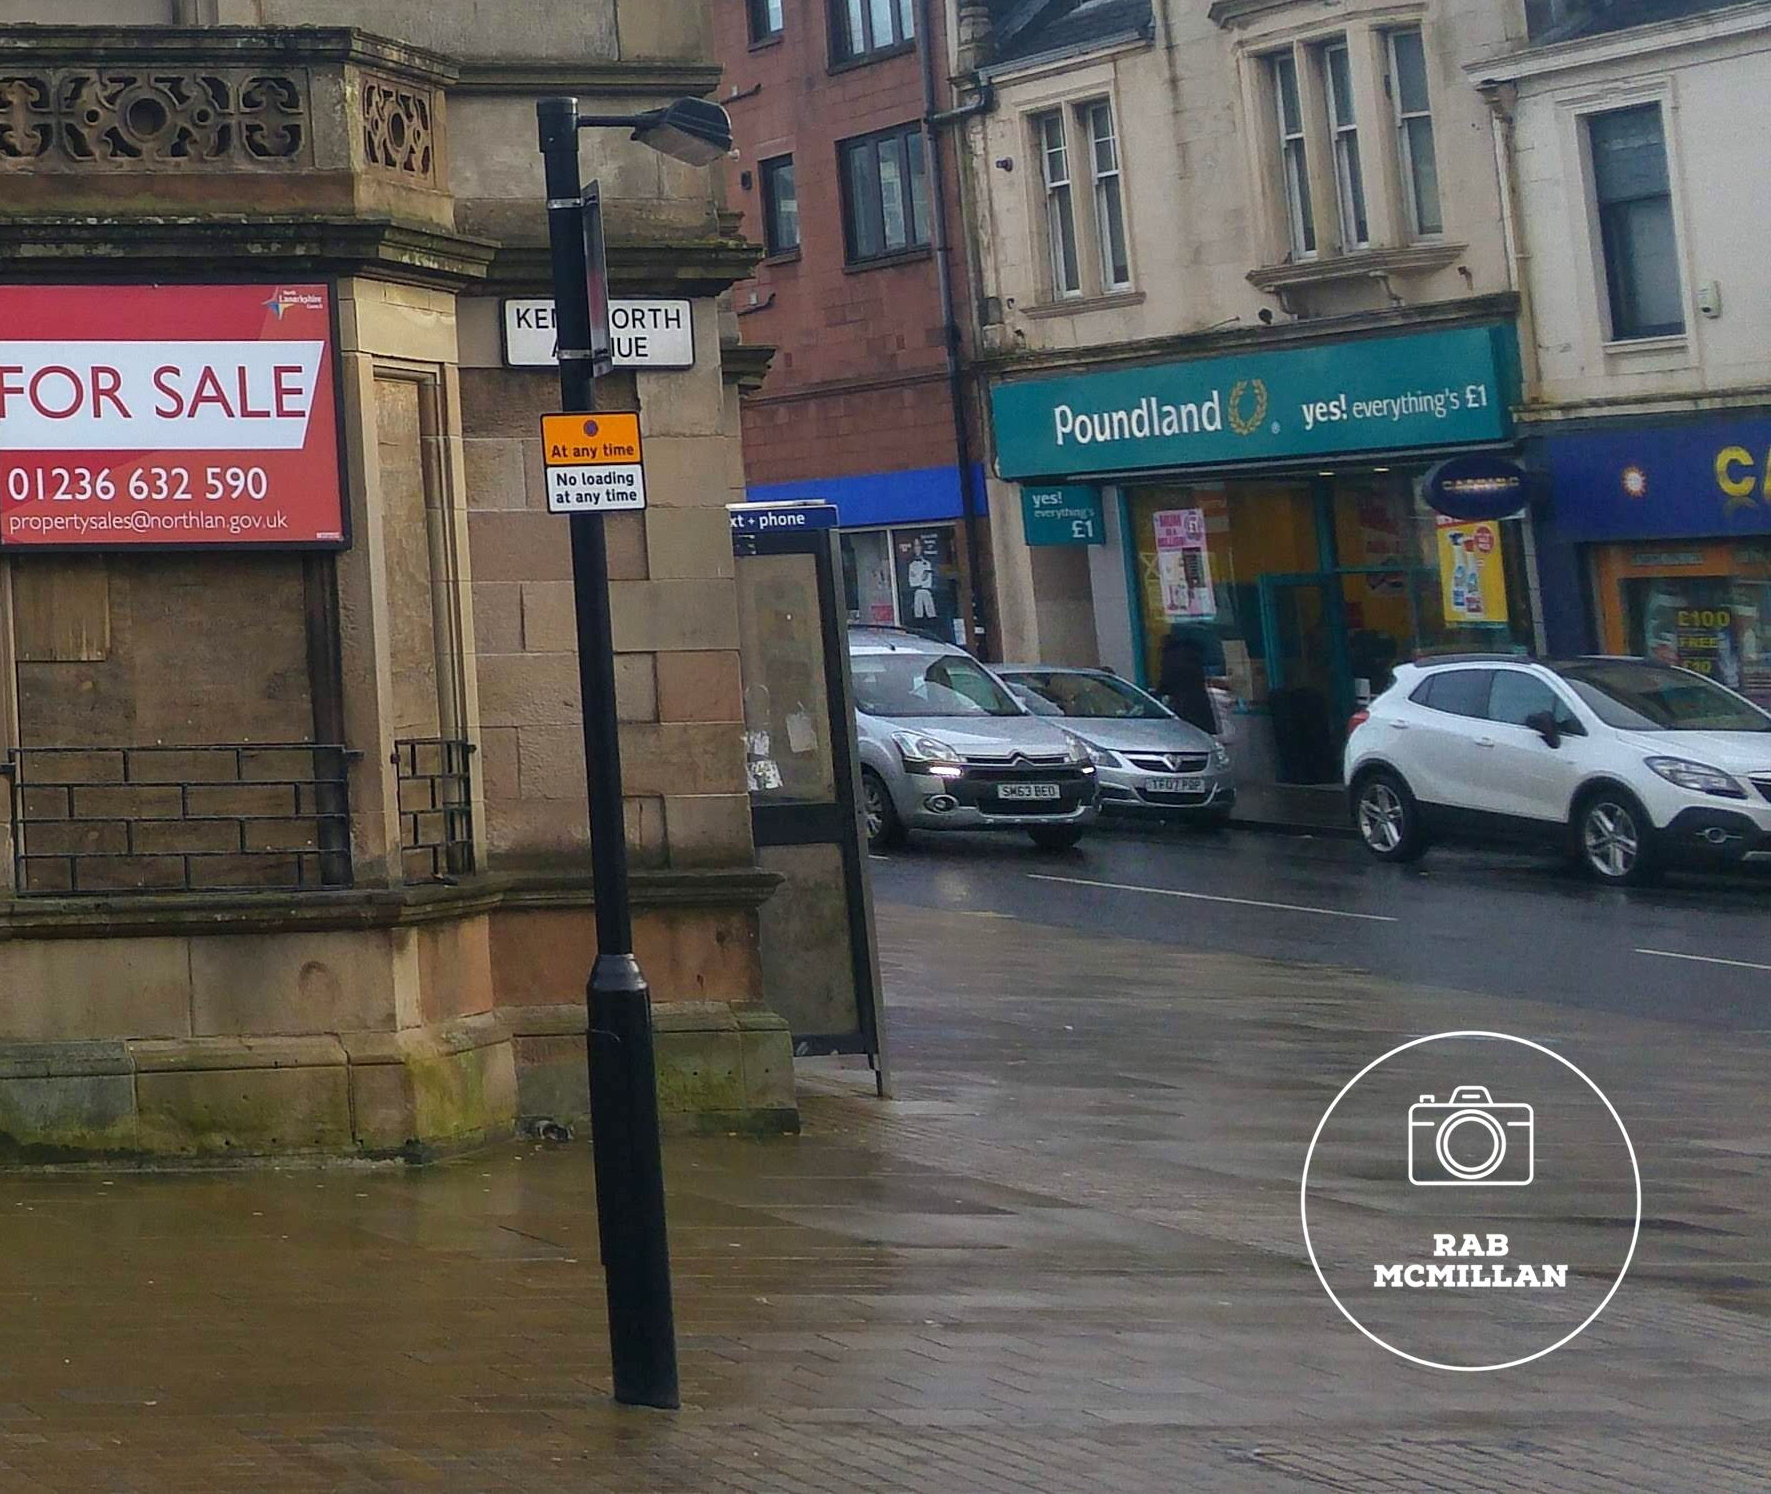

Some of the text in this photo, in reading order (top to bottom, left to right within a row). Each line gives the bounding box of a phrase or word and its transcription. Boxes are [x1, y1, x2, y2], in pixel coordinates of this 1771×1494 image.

[279, 294, 322, 304] Lanarkshire
[153, 365, 307, 419] SALE
[1054, 384, 1488, 445] Poundland yes! everything's £1
[551, 443, 635, 459] At any time
[9, 467, 269, 500] 01236 632 590
[556, 471, 635, 487] No loading
[555, 488, 637, 505] at any time
[1032, 491, 1062, 508] yes!
[759, 511, 805, 530] phone
[1034, 507, 1094, 520] everything's
[9, 510, 288, 535] propertysales@northlan.gov.uk
[1071, 520, 1093, 538] £1
